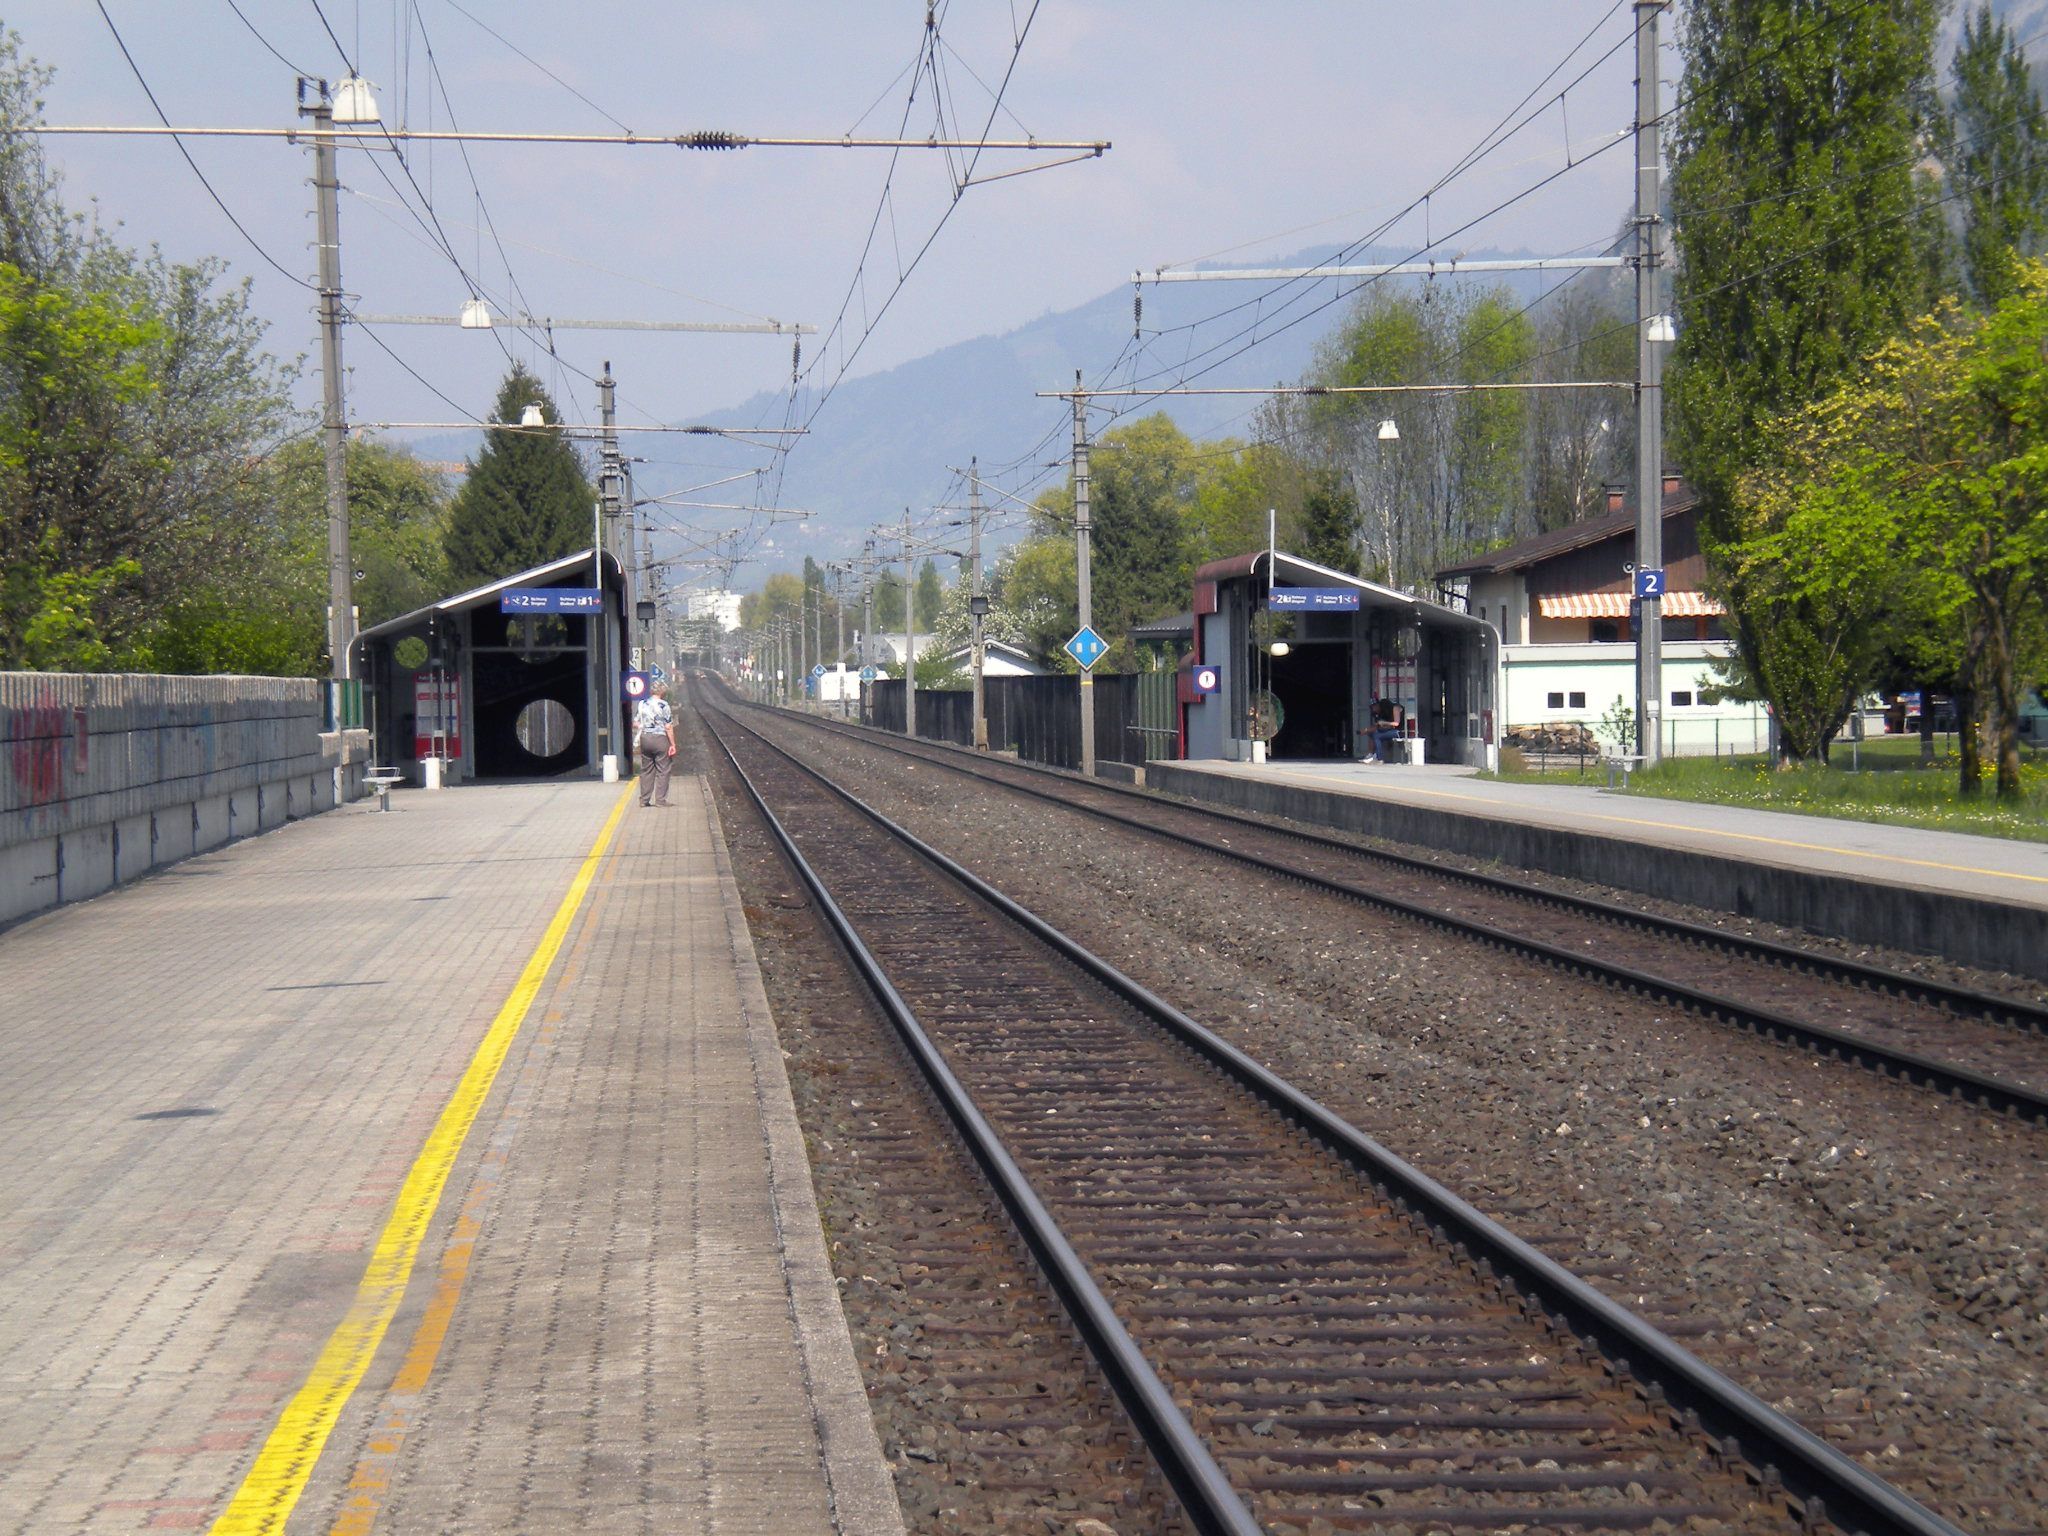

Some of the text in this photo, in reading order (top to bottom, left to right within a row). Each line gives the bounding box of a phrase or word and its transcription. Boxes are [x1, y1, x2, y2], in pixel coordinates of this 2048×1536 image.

[1645, 575, 1658, 592] 2
[522, 596, 529, 606] 2
[587, 596, 593, 606] 1
[1277, 594, 1283, 604] 2
[1338, 594, 1343, 604] 1
